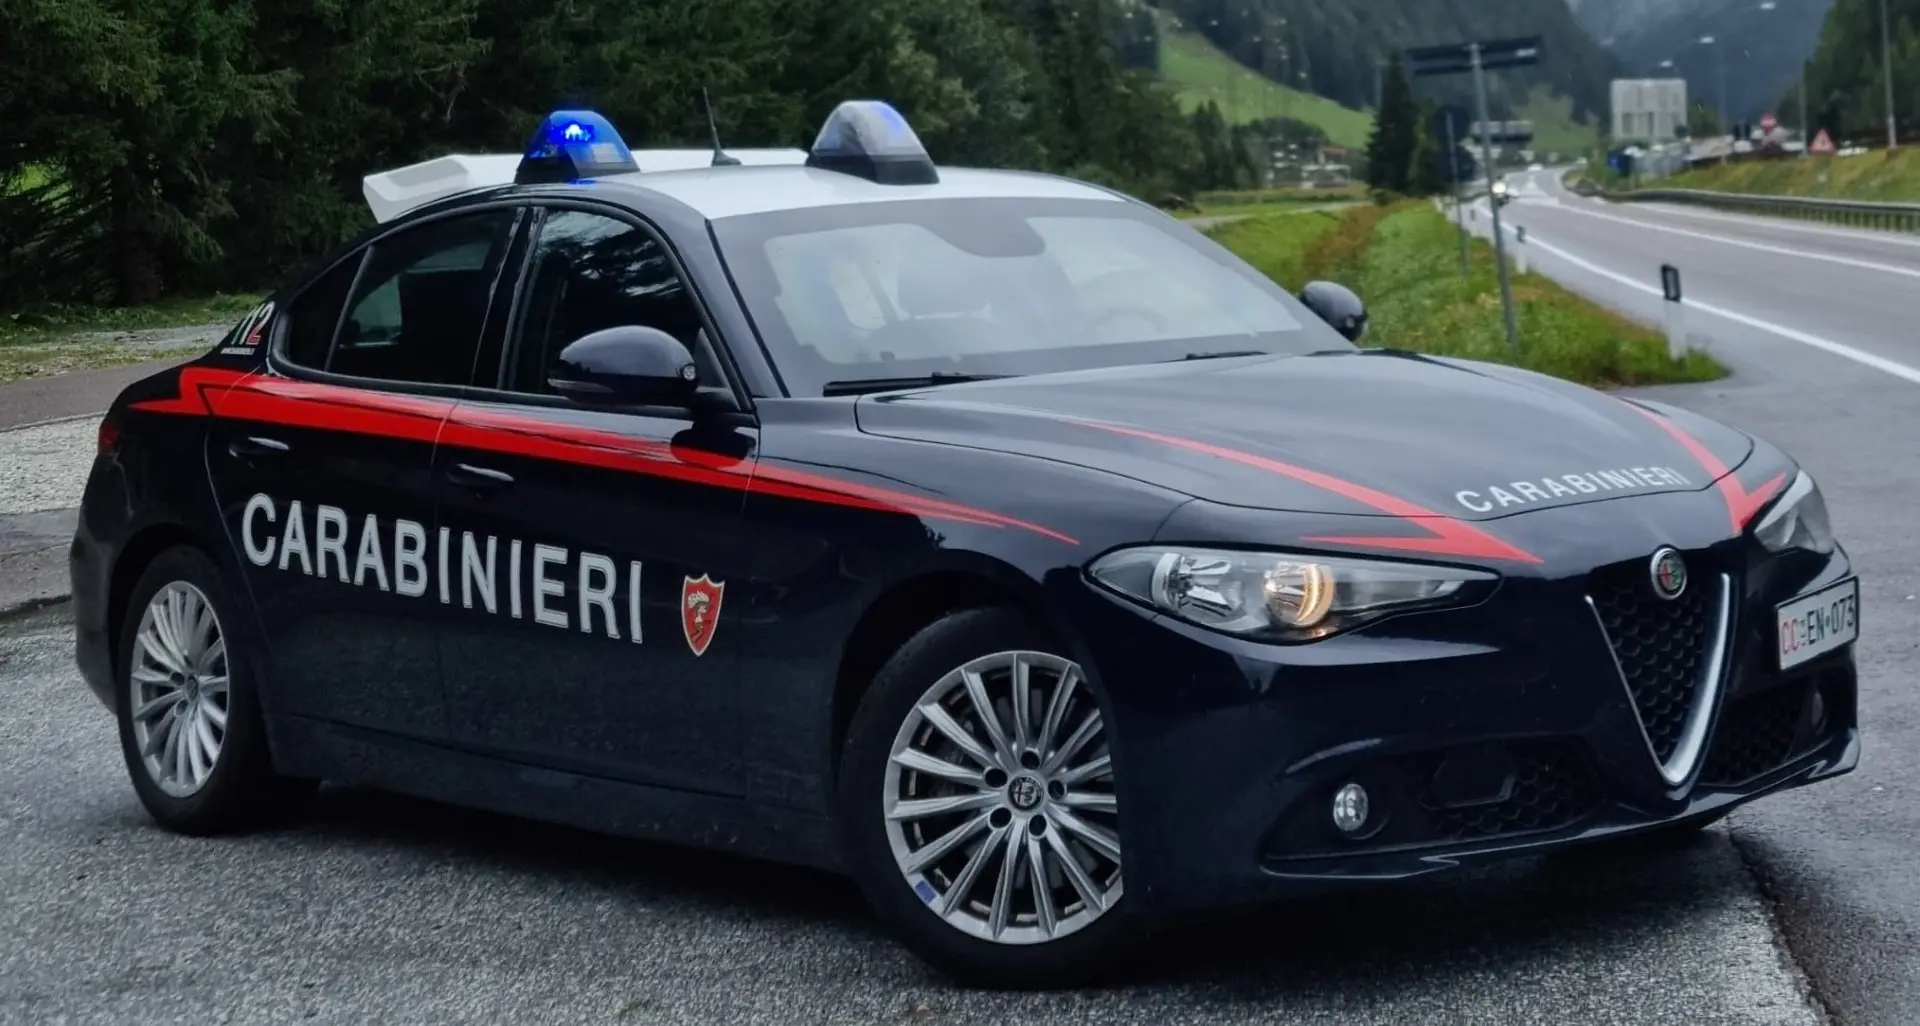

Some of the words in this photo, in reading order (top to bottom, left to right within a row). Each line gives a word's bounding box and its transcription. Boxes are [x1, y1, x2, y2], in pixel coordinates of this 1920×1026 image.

[231, 301, 275, 346] 112
[1455, 466, 1692, 513] CARABINIERI
[242, 493, 643, 644] CARABINIERI
